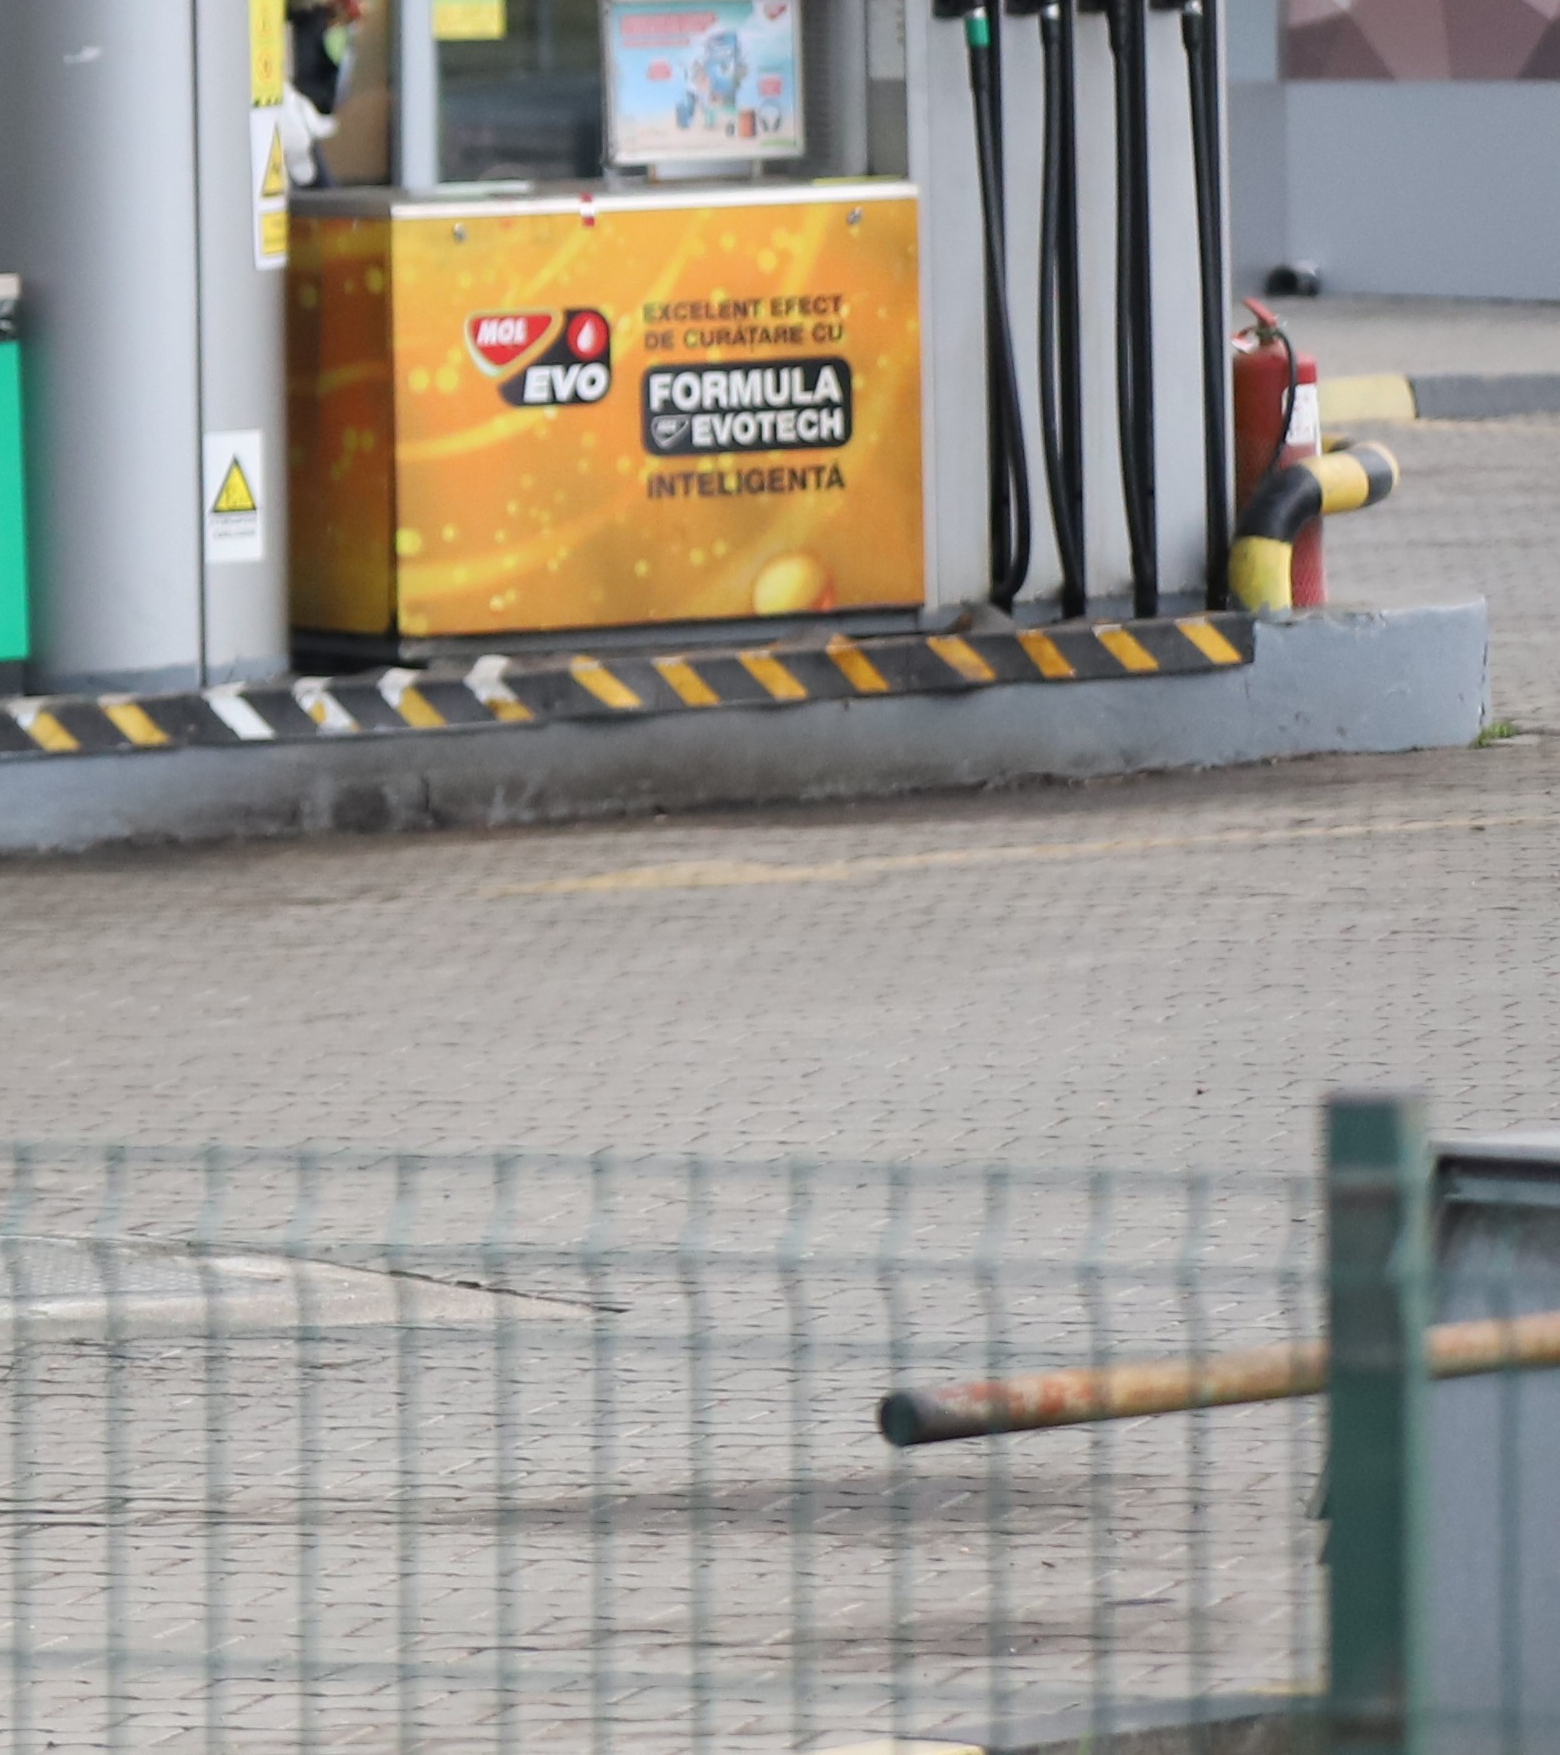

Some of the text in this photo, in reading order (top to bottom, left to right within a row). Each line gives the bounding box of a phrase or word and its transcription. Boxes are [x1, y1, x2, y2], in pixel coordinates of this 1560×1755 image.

[643, 294, 843, 322] EXCELENT EFECT
[476, 319, 528, 346] MOL
[811, 322, 844, 343] CU
[523, 363, 609, 403] EVO
[648, 364, 844, 413] FORMULA
[691, 406, 845, 447] EVOTECH
